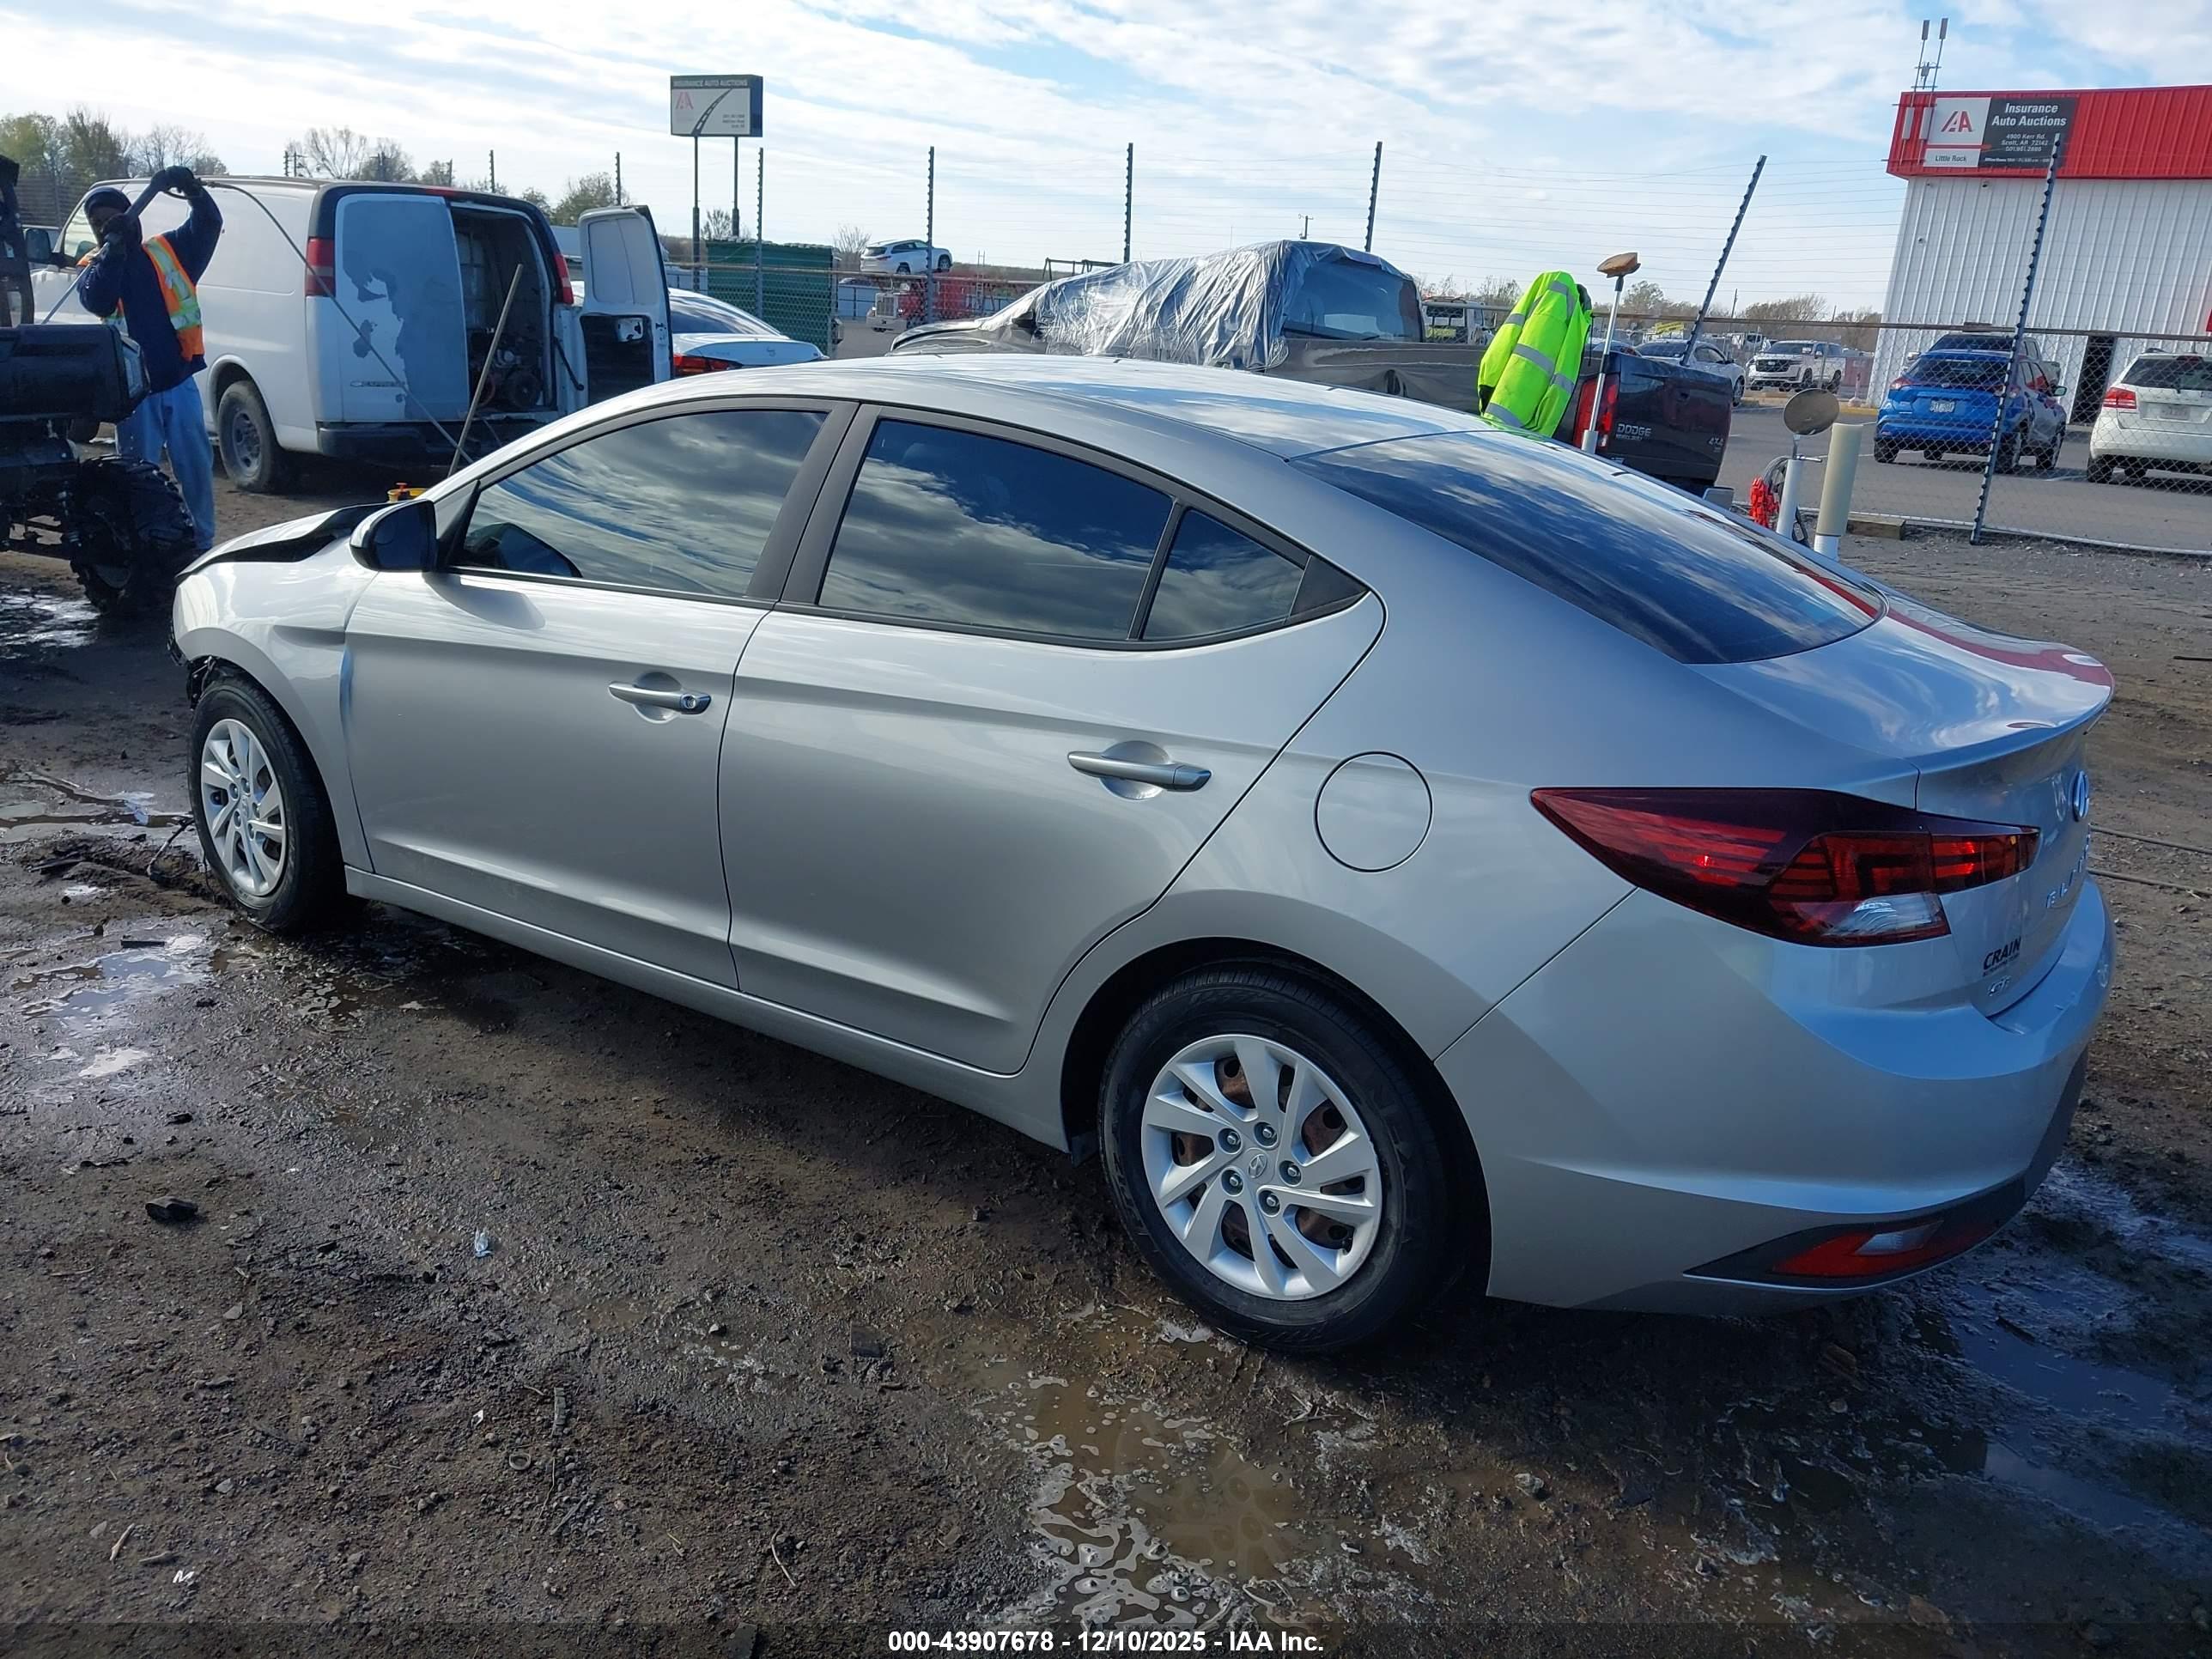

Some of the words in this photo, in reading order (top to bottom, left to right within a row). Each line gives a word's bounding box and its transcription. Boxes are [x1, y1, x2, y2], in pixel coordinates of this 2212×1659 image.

[2005, 102, 2059, 114] Insurance
[1991, 115, 2016, 126] Auto
[2017, 115, 2067, 126] Auctions
[1617, 422, 1652, 437] DODGE
[1983, 935, 2021, 970] CRAIN
